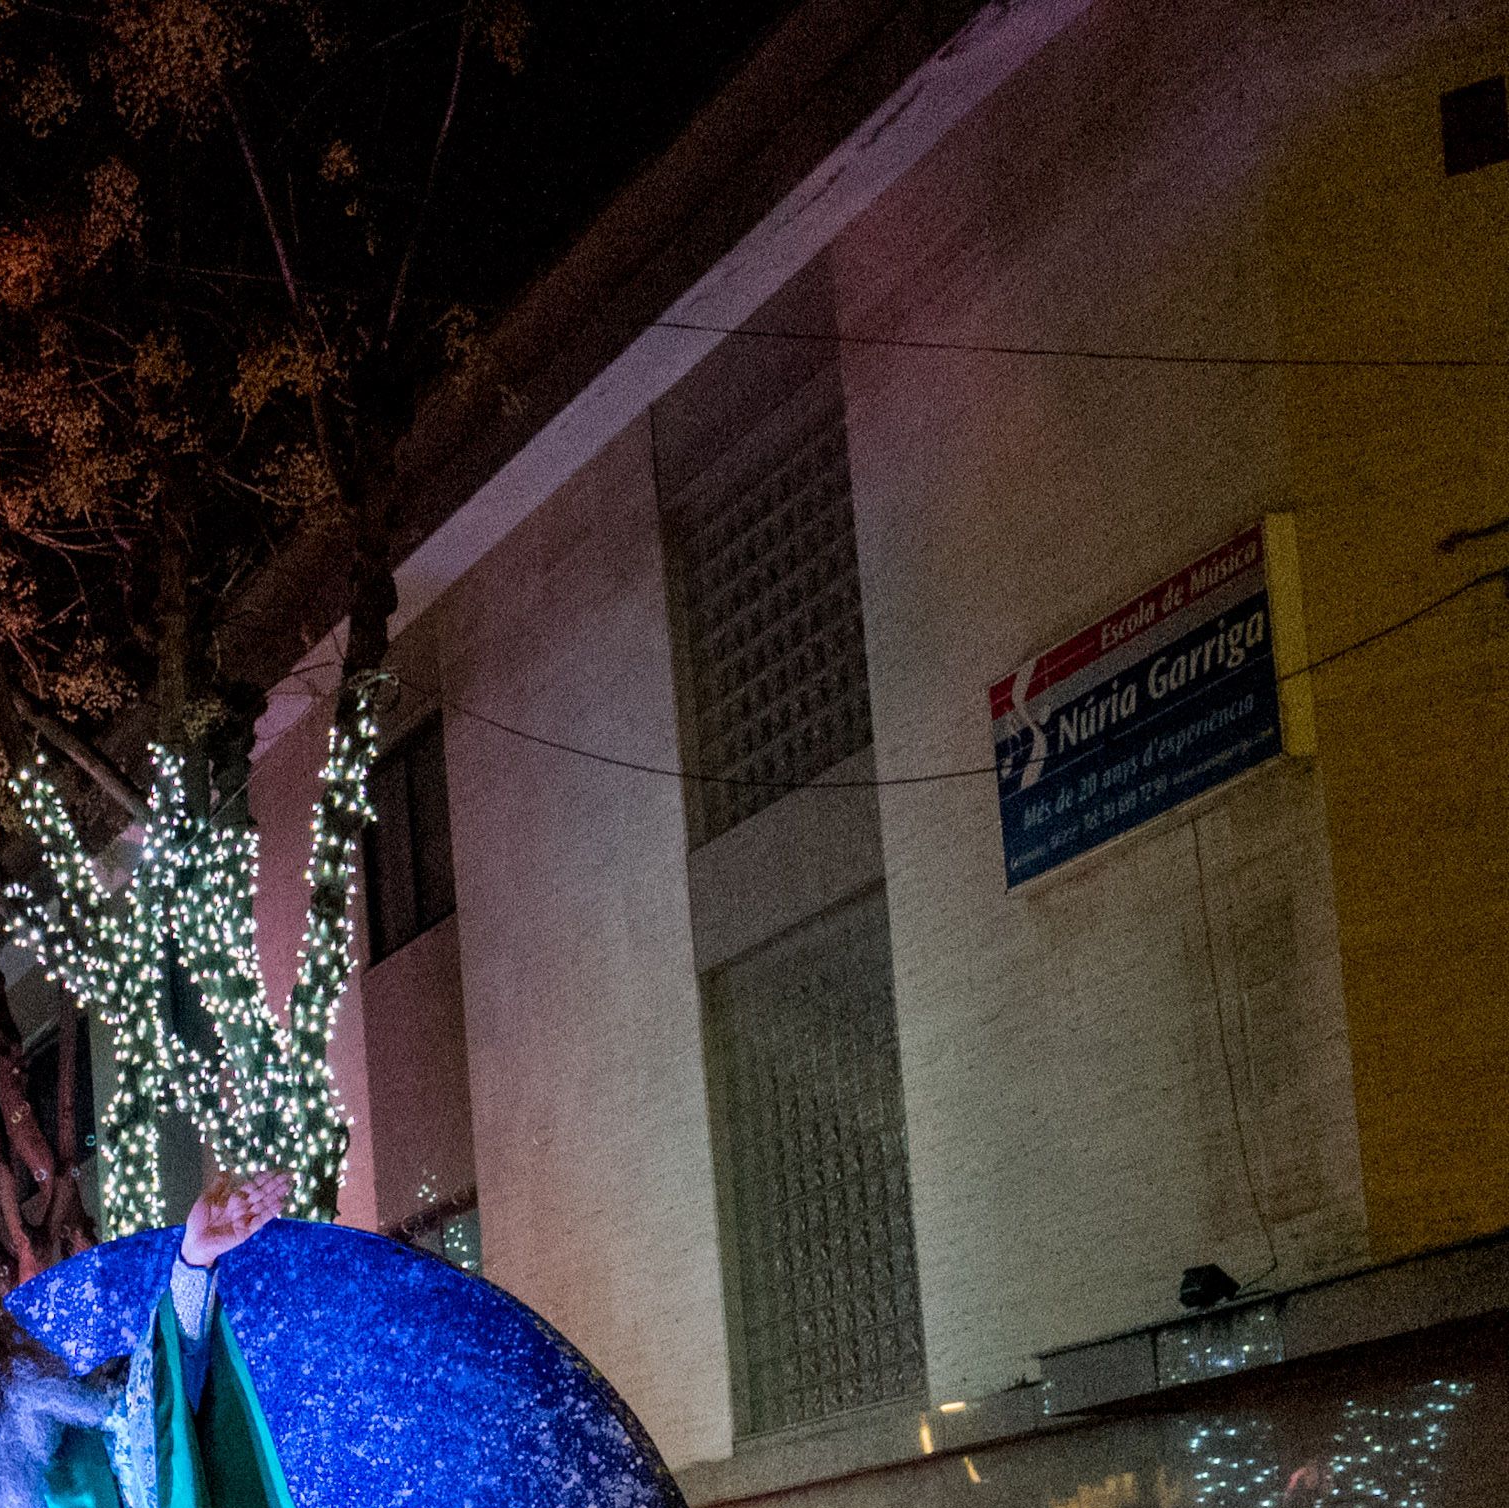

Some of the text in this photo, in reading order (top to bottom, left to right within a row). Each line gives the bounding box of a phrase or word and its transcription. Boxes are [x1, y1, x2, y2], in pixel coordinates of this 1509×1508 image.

[1099, 539, 1259, 651] Escola de Música
[1057, 606, 1267, 752] Núria Garriga
[1055, 786, 1074, 815] de
